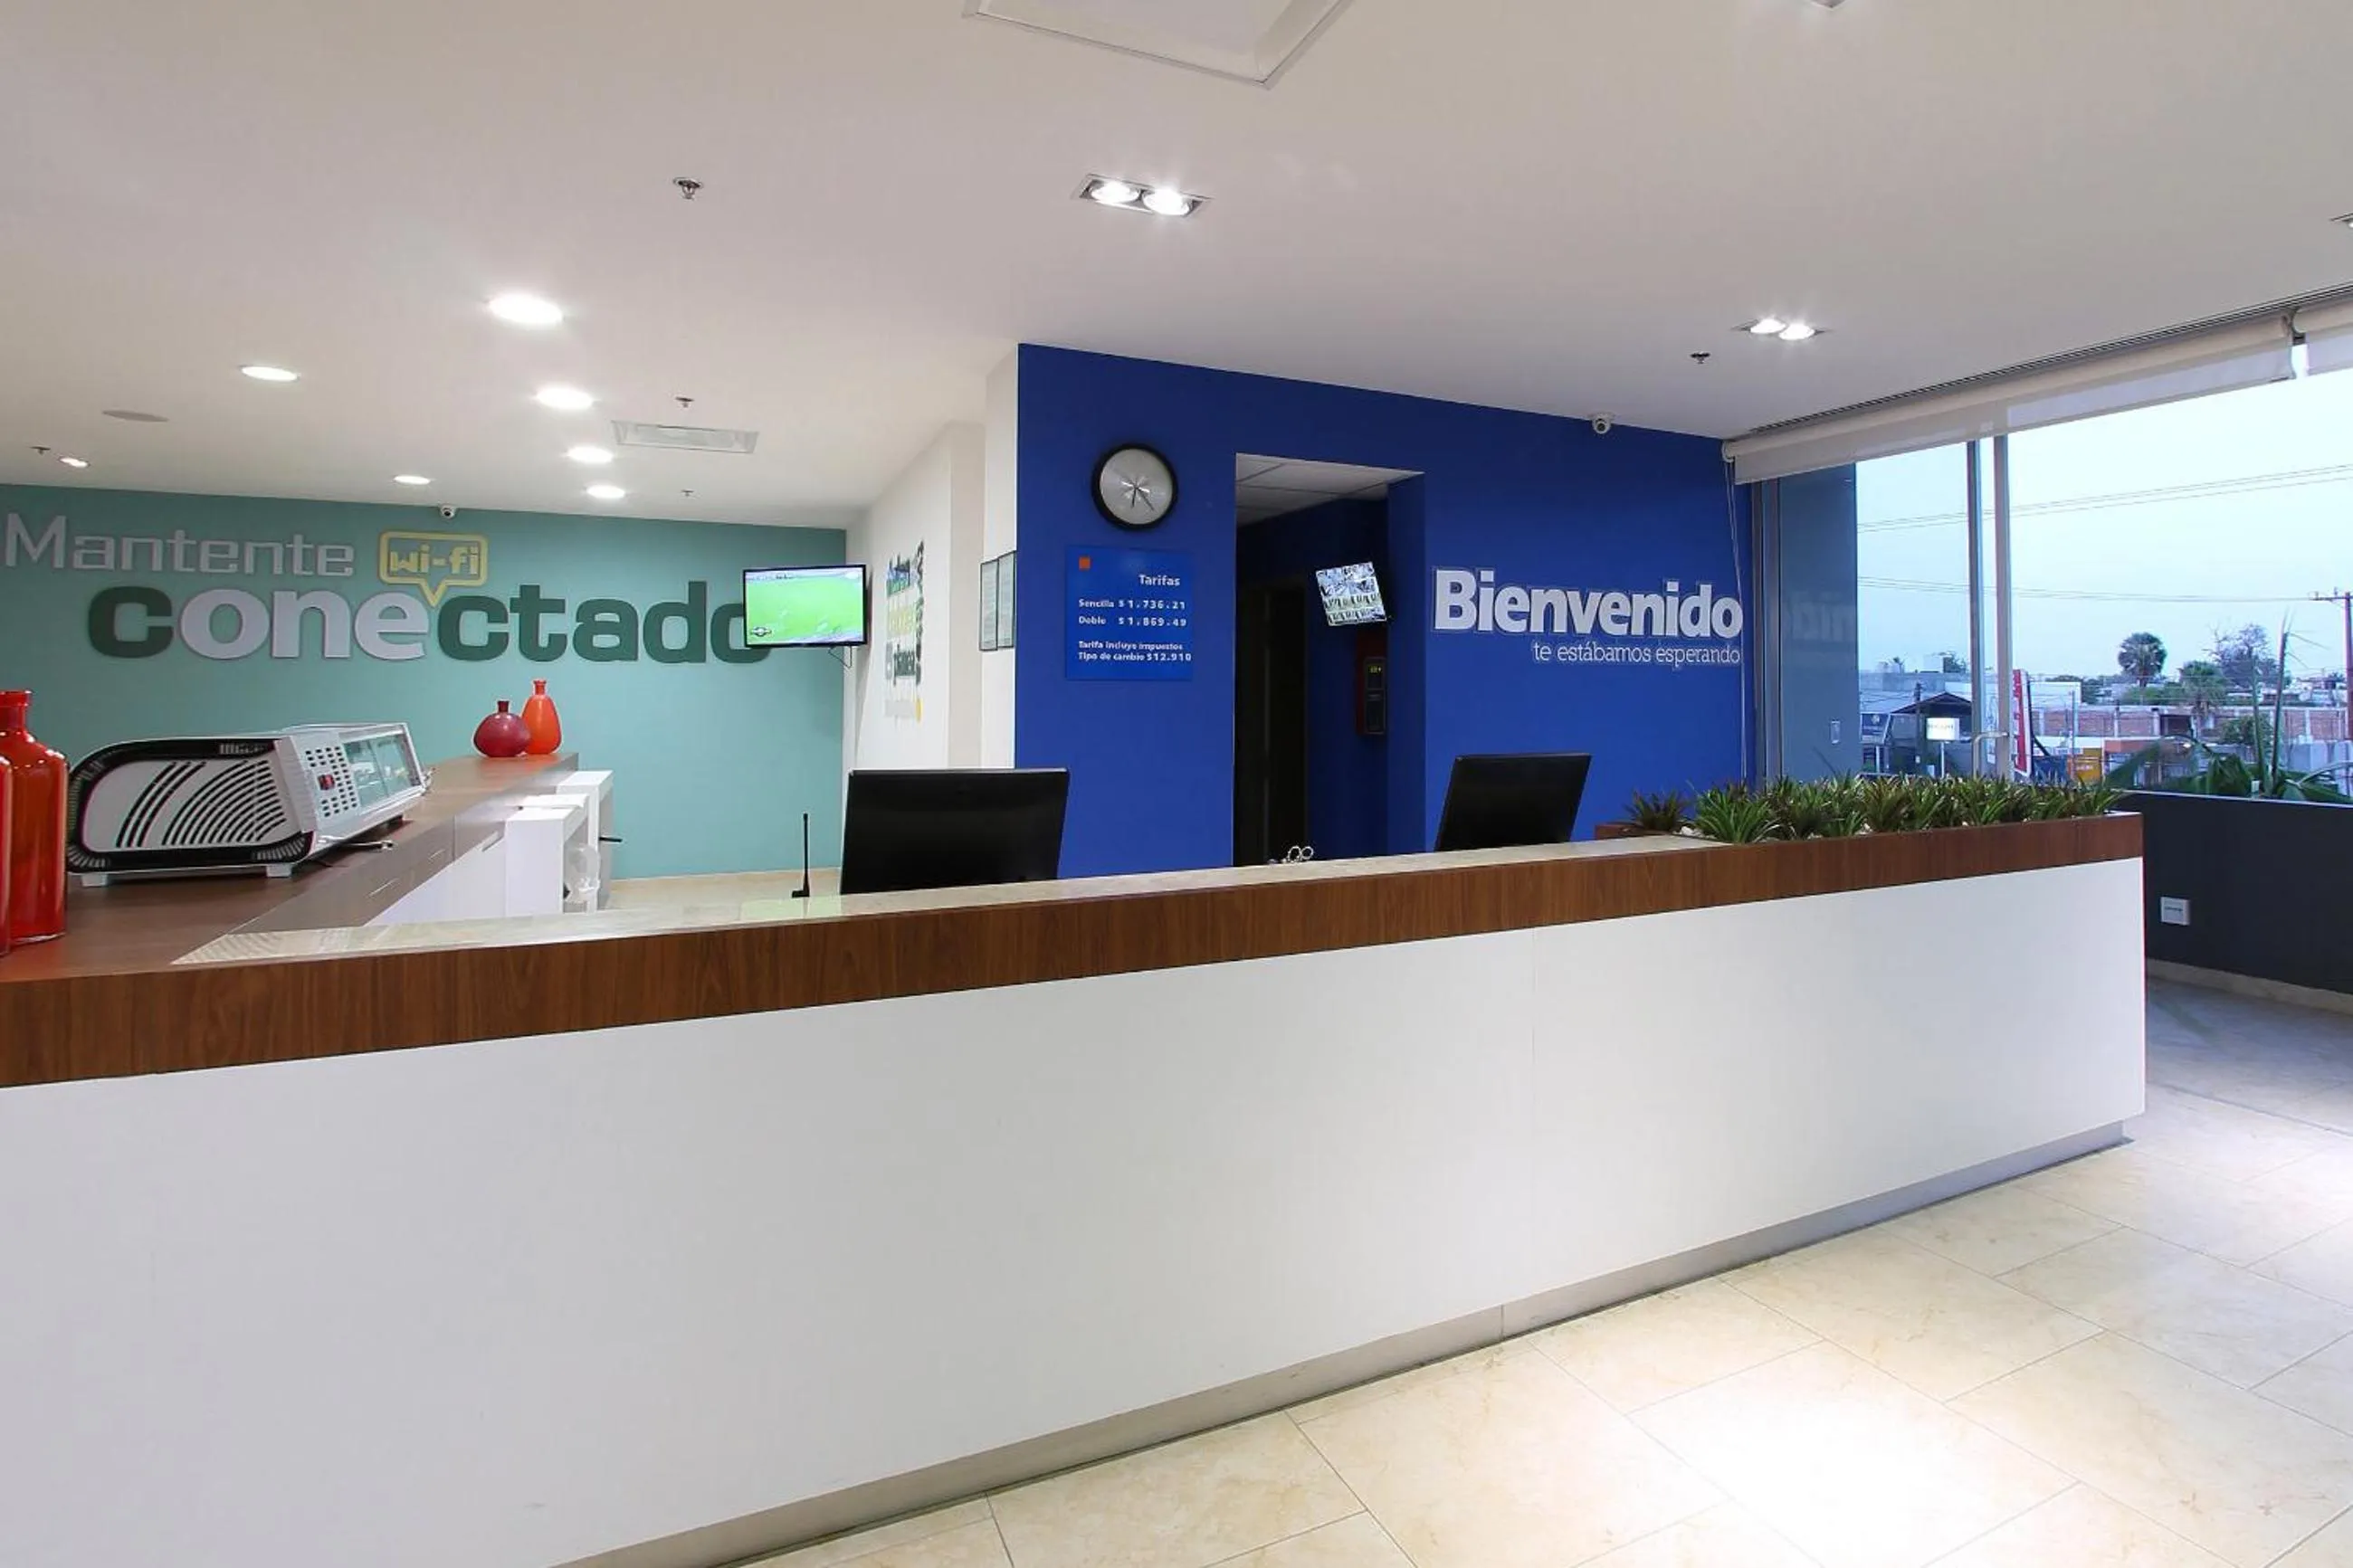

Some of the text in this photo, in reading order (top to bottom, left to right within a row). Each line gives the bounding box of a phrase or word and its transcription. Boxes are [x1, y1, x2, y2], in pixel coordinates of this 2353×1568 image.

[5, 512, 356, 577] Mantente
[389, 543, 479, 575] wi-fi
[1138, 574, 1181, 586] Tarifas
[1078, 598, 1114, 608] Sencilla
[1434, 569, 1744, 639] Bienvenido
[1078, 615, 1106, 625] Doble
[1078, 641, 1103, 649] Tarifa
[1138, 642, 1183, 651] impuestos
[1078, 651, 1098, 661] Tipo
[1099, 652, 1111, 660] de
[1113, 652, 1145, 661] cambio
[1533, 641, 1740, 669] te estábamos esperando
